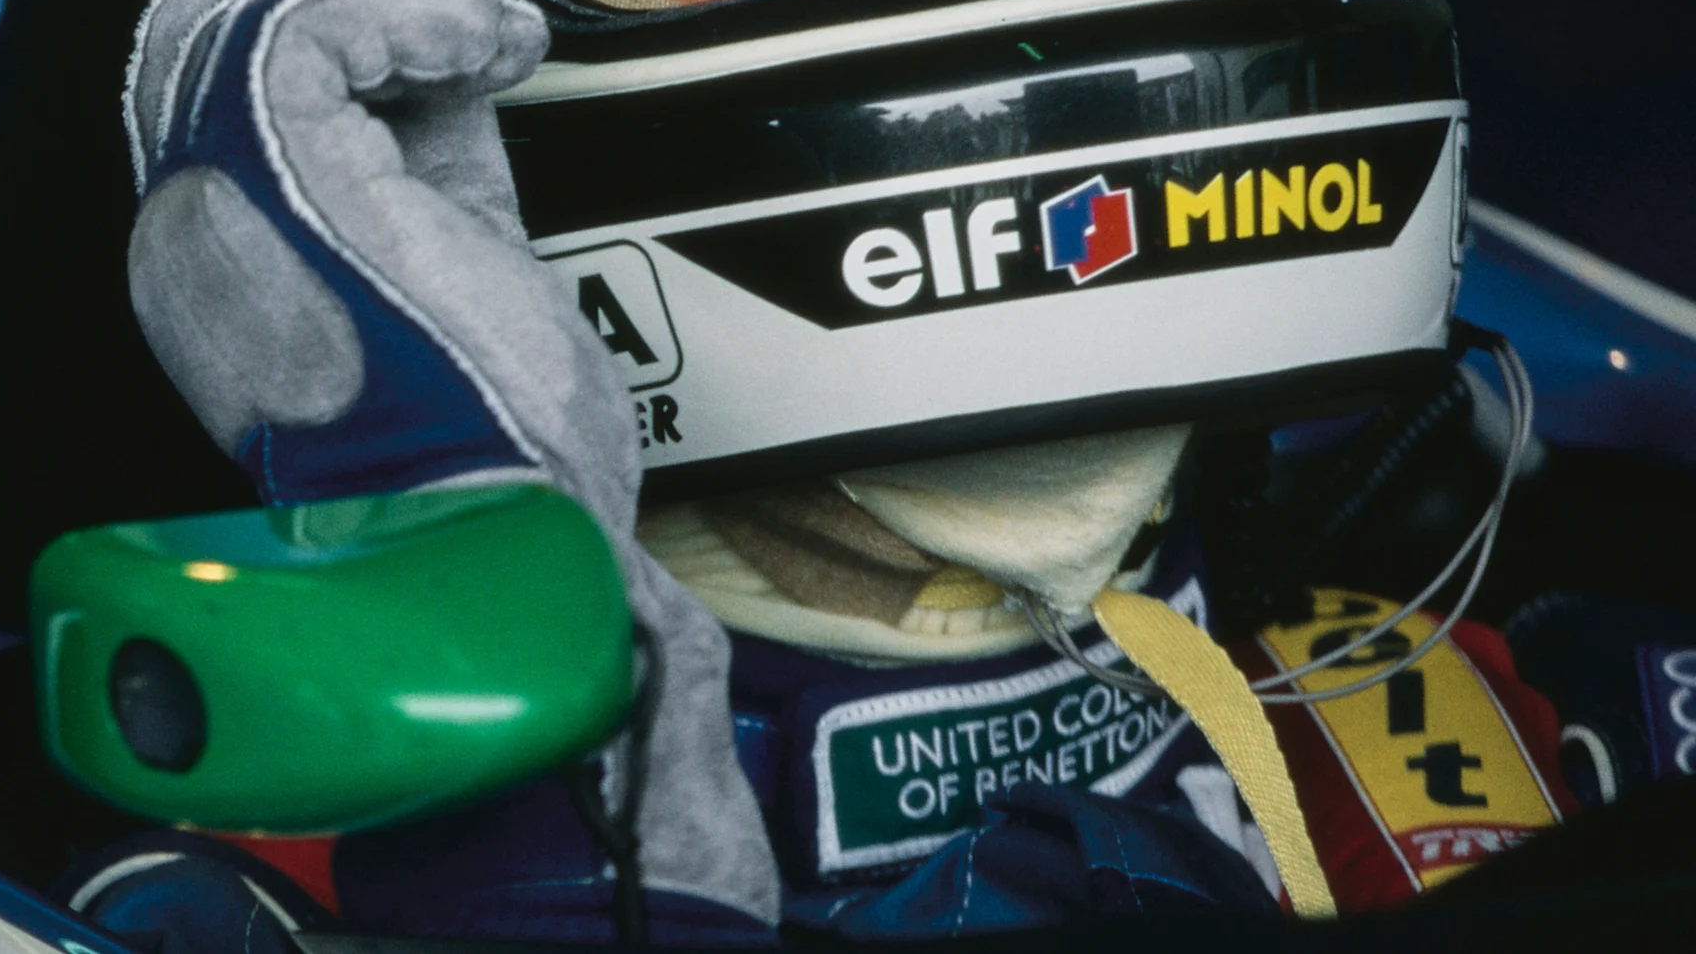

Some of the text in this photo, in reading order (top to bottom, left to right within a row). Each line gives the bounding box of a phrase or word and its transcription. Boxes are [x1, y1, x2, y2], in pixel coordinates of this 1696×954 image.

[842, 157, 1383, 308] elf MINOL
[873, 708, 1042, 777] UNITED
[898, 697, 1170, 821] OF BENETTON
